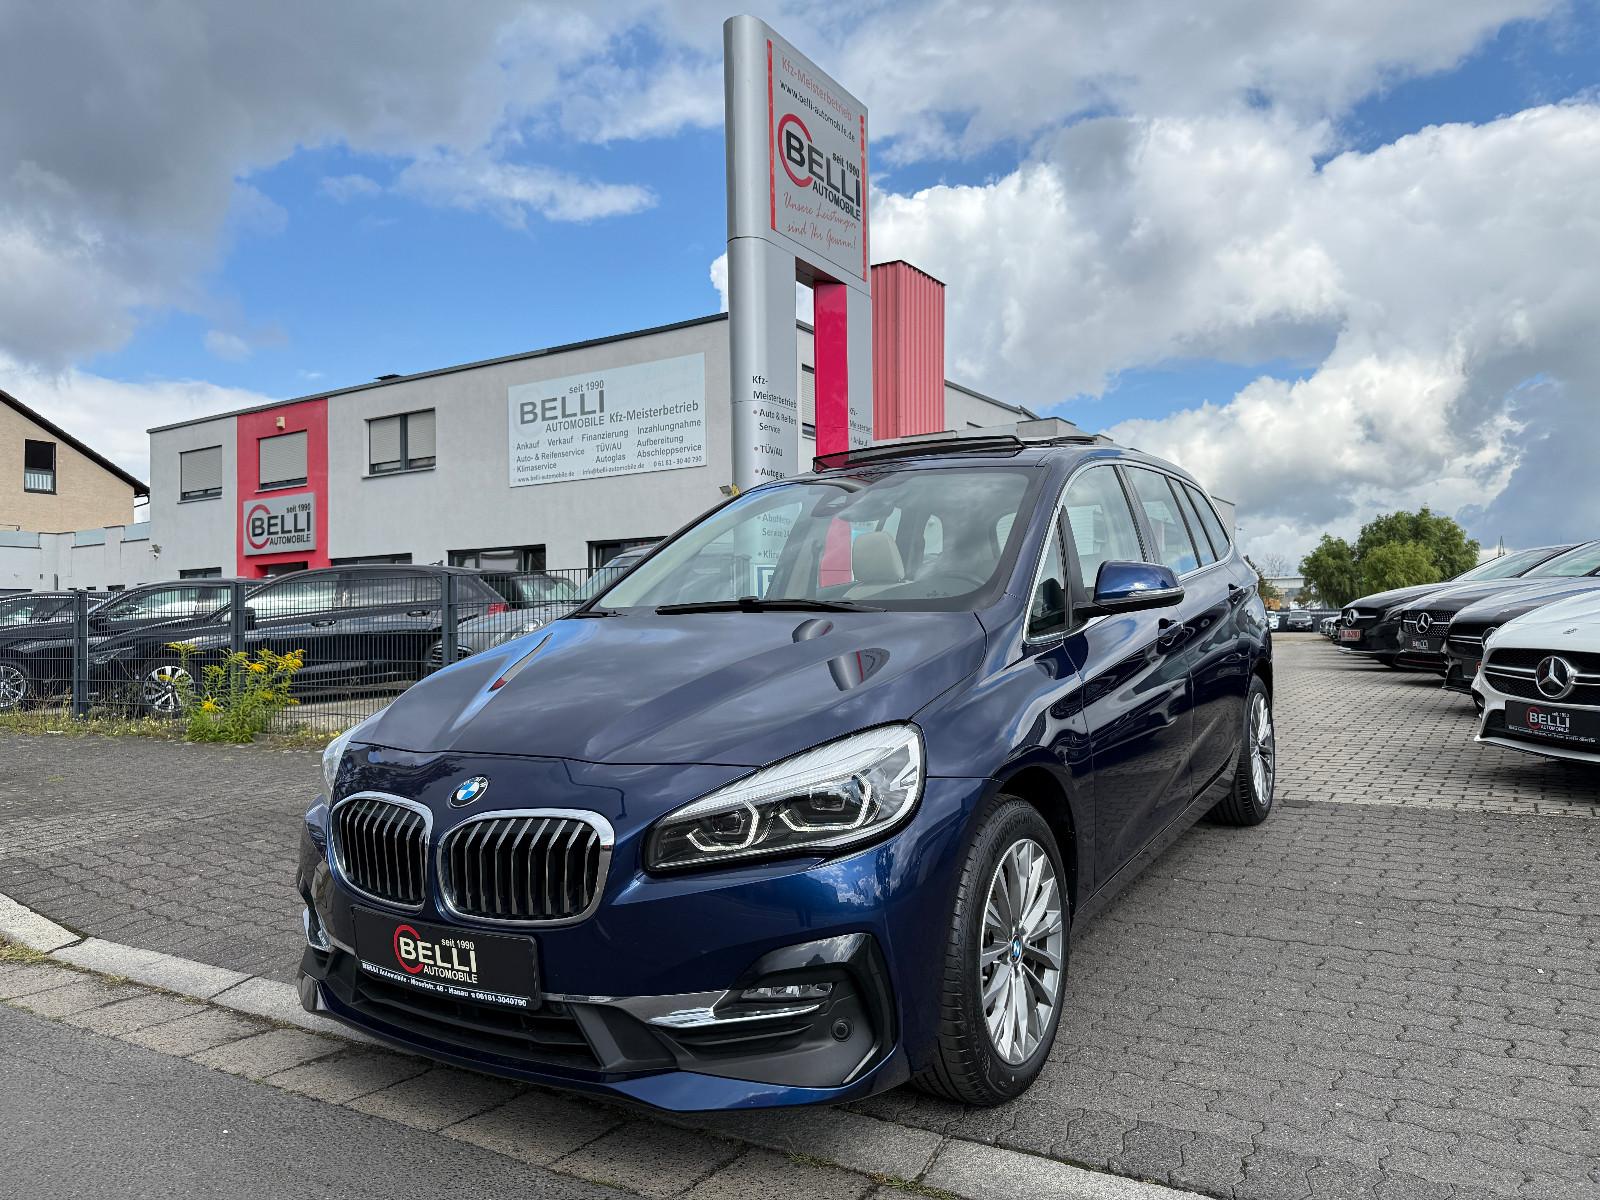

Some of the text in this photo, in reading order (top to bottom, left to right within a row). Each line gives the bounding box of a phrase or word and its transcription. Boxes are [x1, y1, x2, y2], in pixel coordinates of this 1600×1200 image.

[782, 57, 851, 121] Kfz-Meisterbetrieb
[786, 129, 860, 208] BELLI
[832, 152, 860, 178] seit 1990
[784, 192, 813, 214] Unsere
[812, 180, 861, 222] AUTOMOBILE
[788, 220, 807, 236] sind
[569, 380, 604, 394] seit 1990
[752, 375, 768, 384] Kfz-
[520, 390, 605, 425] BELLI
[753, 390, 797, 408] Meisterbetrieb
[609, 400, 699, 423] Kfz-Meisterbetrieb
[545, 415, 605, 433] AUTOMOBILE
[760, 422, 781, 434] Service
[516, 419, 702, 451] Ankauf Verkauf Finanzierung Inzahlungnahme
[516, 455, 534, 463] Auto-
[541, 448, 585, 460] Reifenservice
[637, 435, 684, 448] Aufbereitung
[516, 443, 702, 473] Klimaservice Autoglas Abschleppservice
[298, 502, 311, 512] 1990
[252, 511, 311, 537] BELLI
[269, 534, 311, 546] AUTOMOBILE
[1530, 712, 1570, 728] BELLI
[400, 936, 477, 973] BELLI
[441, 938, 475, 950] seit 1990
[423, 965, 478, 984] AUTOMOBILE
[448, 987, 469, 997] Hanau
[476, 992, 527, 1007] 06181-3040790
